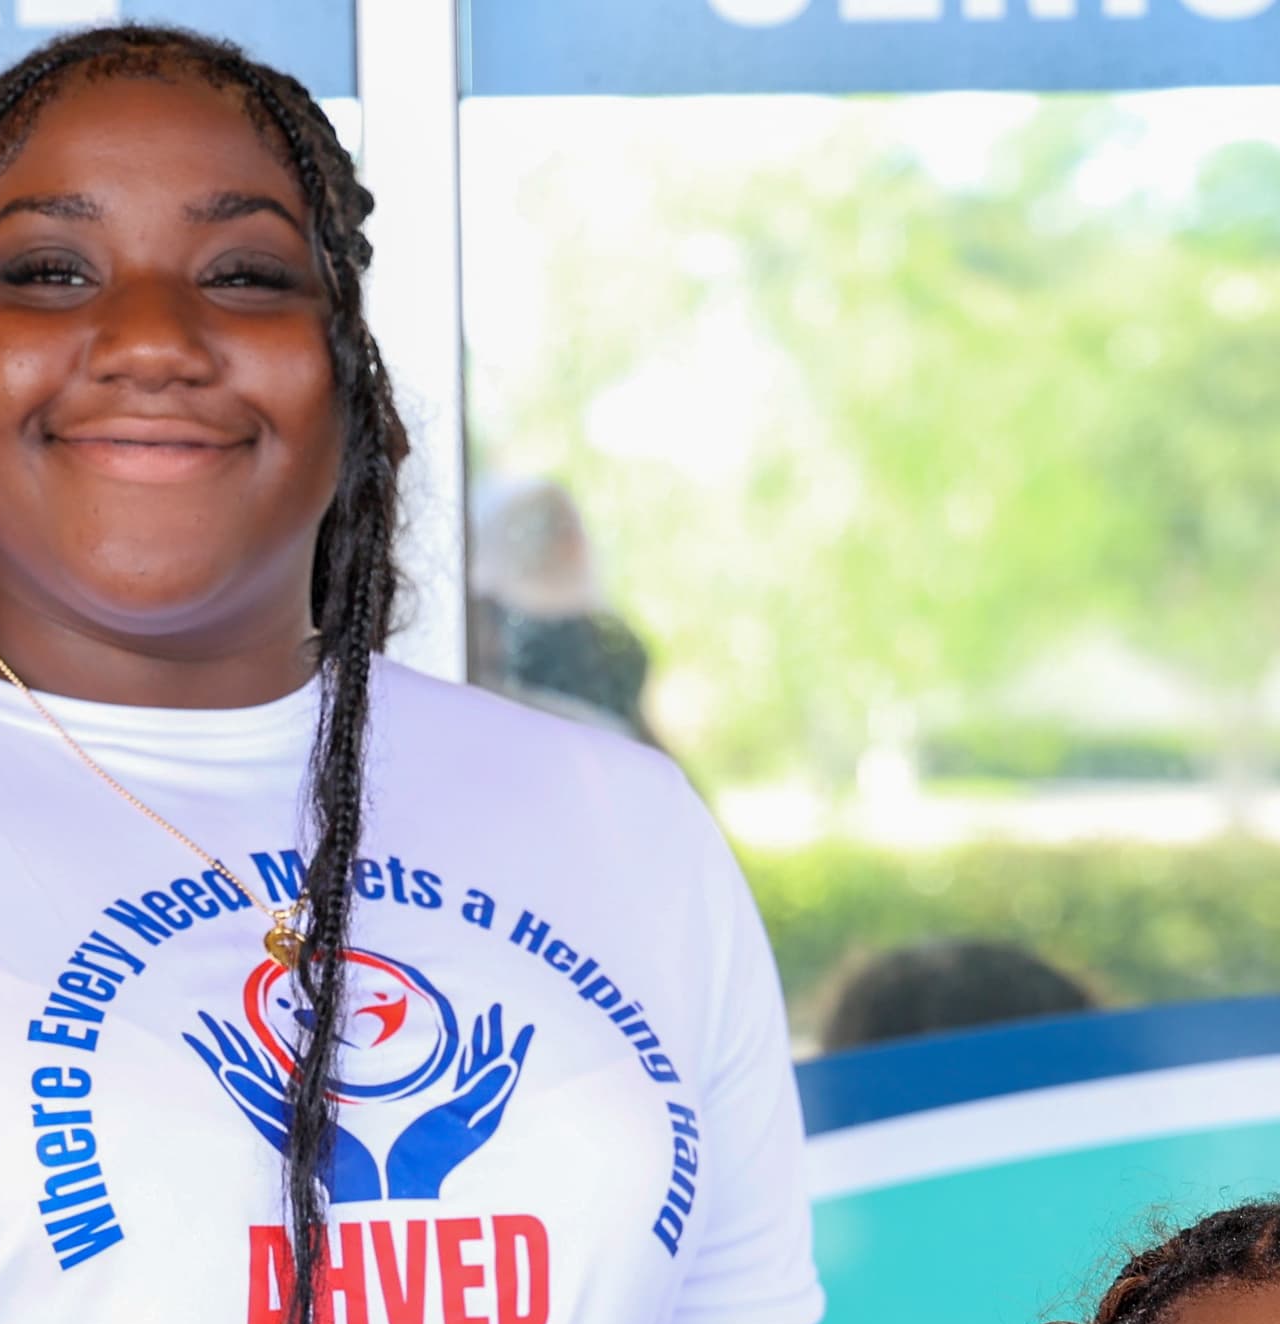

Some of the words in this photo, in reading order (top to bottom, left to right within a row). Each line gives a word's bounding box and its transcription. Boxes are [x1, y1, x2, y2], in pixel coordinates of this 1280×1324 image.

[106, 857, 254, 948] Need
[250, 850, 443, 909] Mets
[461, 887, 497, 929] a
[27, 930, 146, 1052] Every
[508, 910, 681, 1085] Helping
[31, 1066, 124, 1271] Where
[652, 1101, 700, 1259] Hand
